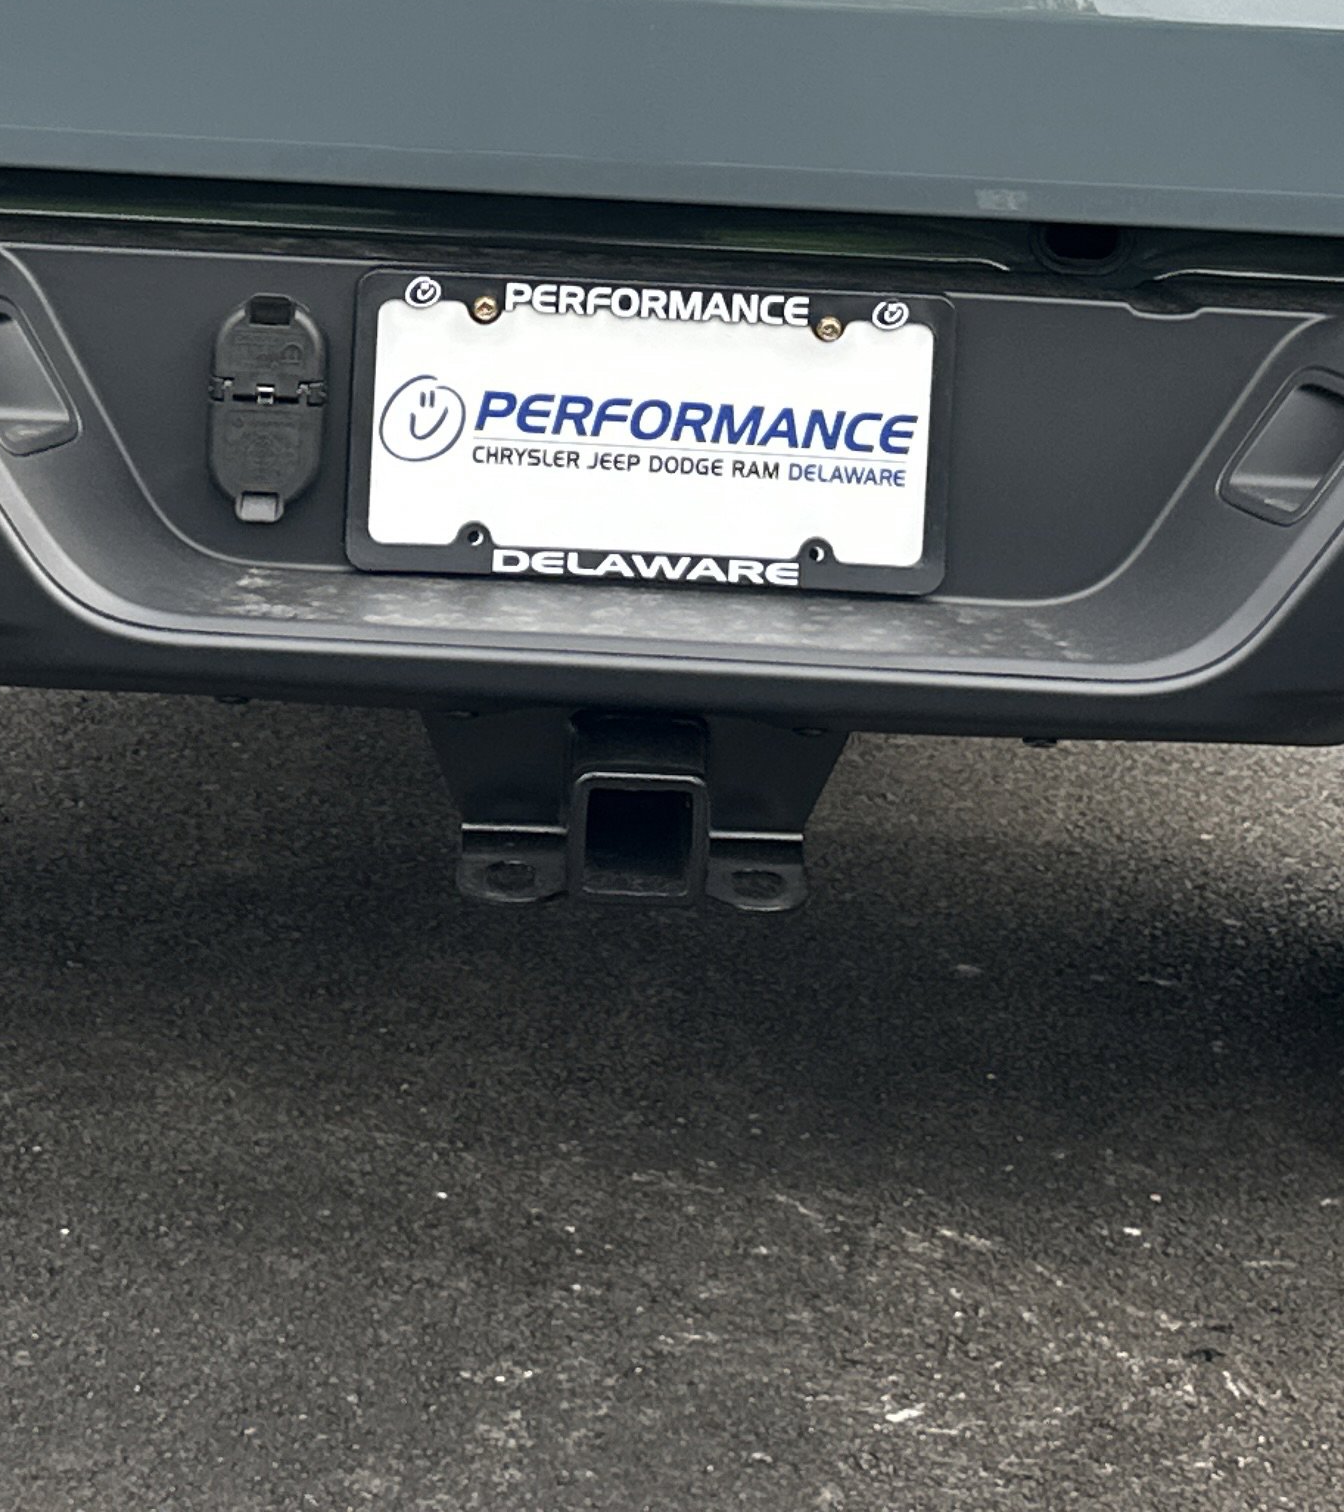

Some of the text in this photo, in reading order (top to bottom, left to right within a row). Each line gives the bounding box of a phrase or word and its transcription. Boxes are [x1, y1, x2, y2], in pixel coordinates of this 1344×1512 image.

[504, 282, 810, 326] PERFORMANCE
[473, 390, 919, 455] PERFORMANCE
[472, 445, 907, 488] CHRYSLER JEEP DODGE RAM DELAWARE
[491, 548, 800, 586] DELAWARE
